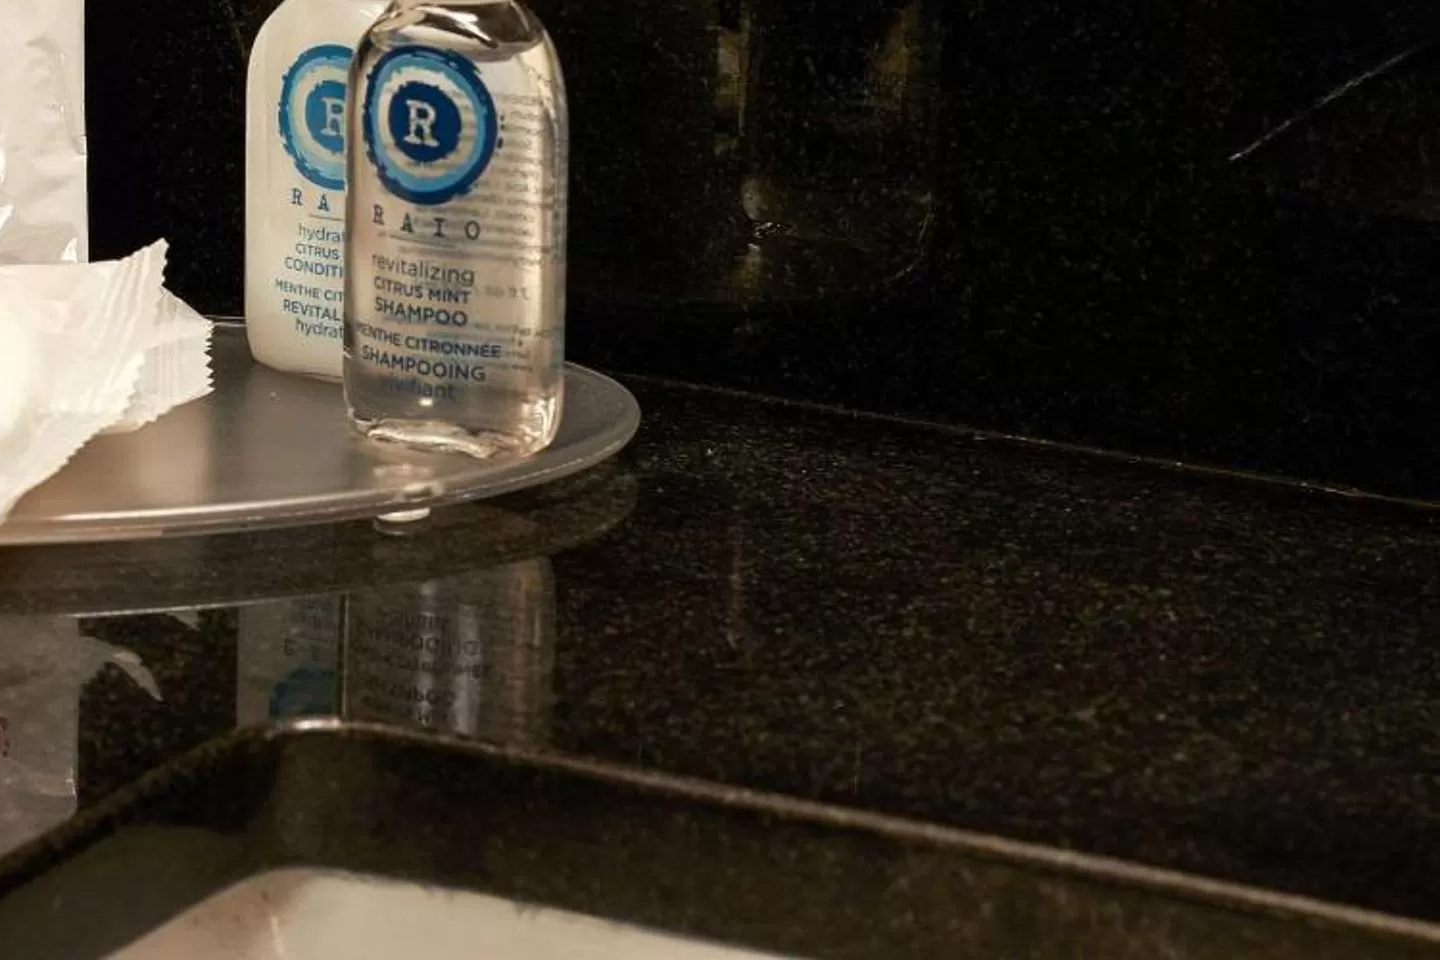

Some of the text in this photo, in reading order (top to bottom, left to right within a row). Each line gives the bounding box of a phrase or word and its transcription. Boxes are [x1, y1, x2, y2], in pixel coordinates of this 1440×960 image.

[404, 99, 439, 148] R
[291, 187, 330, 212] RA
[298, 222, 345, 244] hydra
[372, 204, 482, 241] RAIO
[295, 243, 341, 261] CITRUS
[284, 256, 344, 279] CONDITI
[372, 254, 475, 287] revitalizing
[275, 278, 344, 302] MENTHE CIT
[373, 276, 424, 298] CITRUS
[427, 285, 473, 305] MINT
[283, 299, 342, 322] REVITAL
[373, 297, 469, 328] SHAMPOO
[295, 318, 344, 339] hydrat
[404, 335, 502, 359] CITRONNÉE
[361, 345, 487, 382] SHAMPOOING
